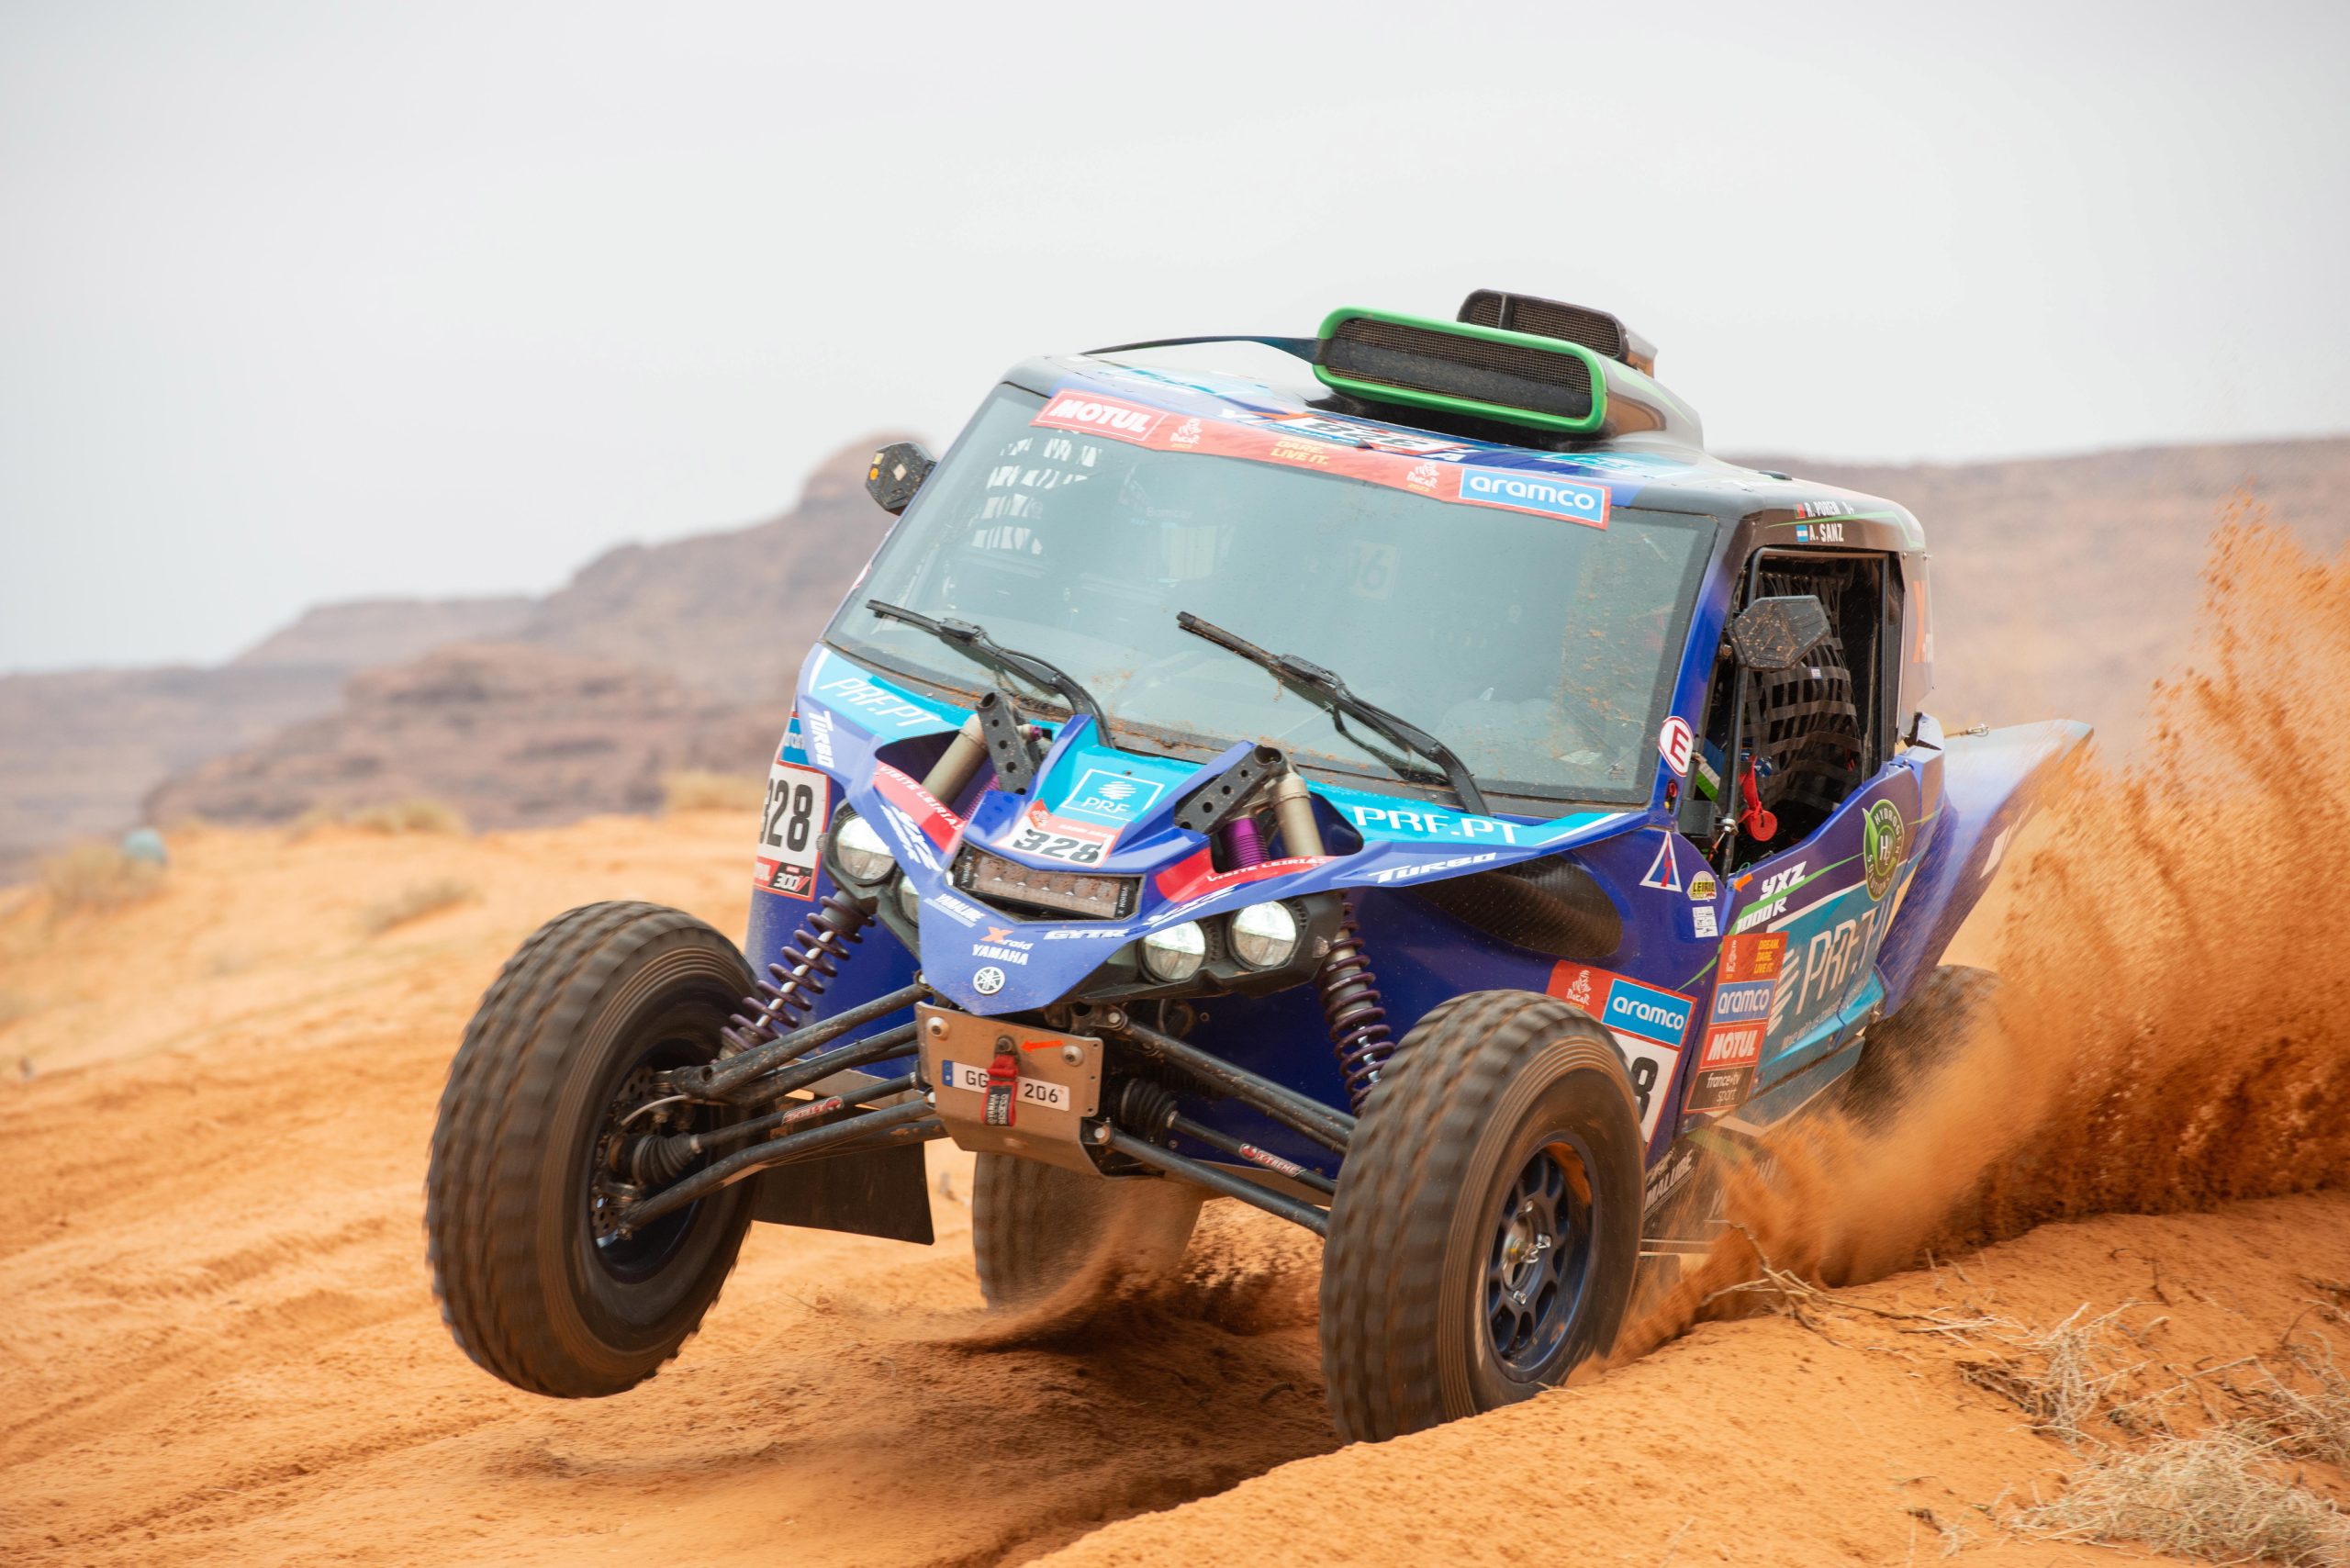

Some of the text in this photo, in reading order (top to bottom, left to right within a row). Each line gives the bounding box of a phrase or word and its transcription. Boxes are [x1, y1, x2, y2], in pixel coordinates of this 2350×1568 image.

[1047, 398, 1152, 432] MOTUL
[1270, 447, 1309, 462] LIVE
[1470, 476, 1595, 510] aramco
[1809, 523, 1844, 543] A. SANZ
[820, 678, 941, 727] PRF.PT
[1669, 728, 1691, 766] E
[1081, 797, 1132, 813] PRF
[1353, 806, 1521, 844] PRF.PT
[1013, 828, 1102, 864] 328
[1760, 861, 1807, 902] YXZ
[1043, 929, 1130, 940] GYTR
[972, 944, 1029, 965] YAMAHA
[1612, 996, 1684, 1030] aramco
[1718, 989, 1770, 1014] aramco
[1707, 1030, 1758, 1060] MOTUL
[1024, 1083, 1058, 1103] 206
[1644, 1148, 1693, 1213] MALUBE
